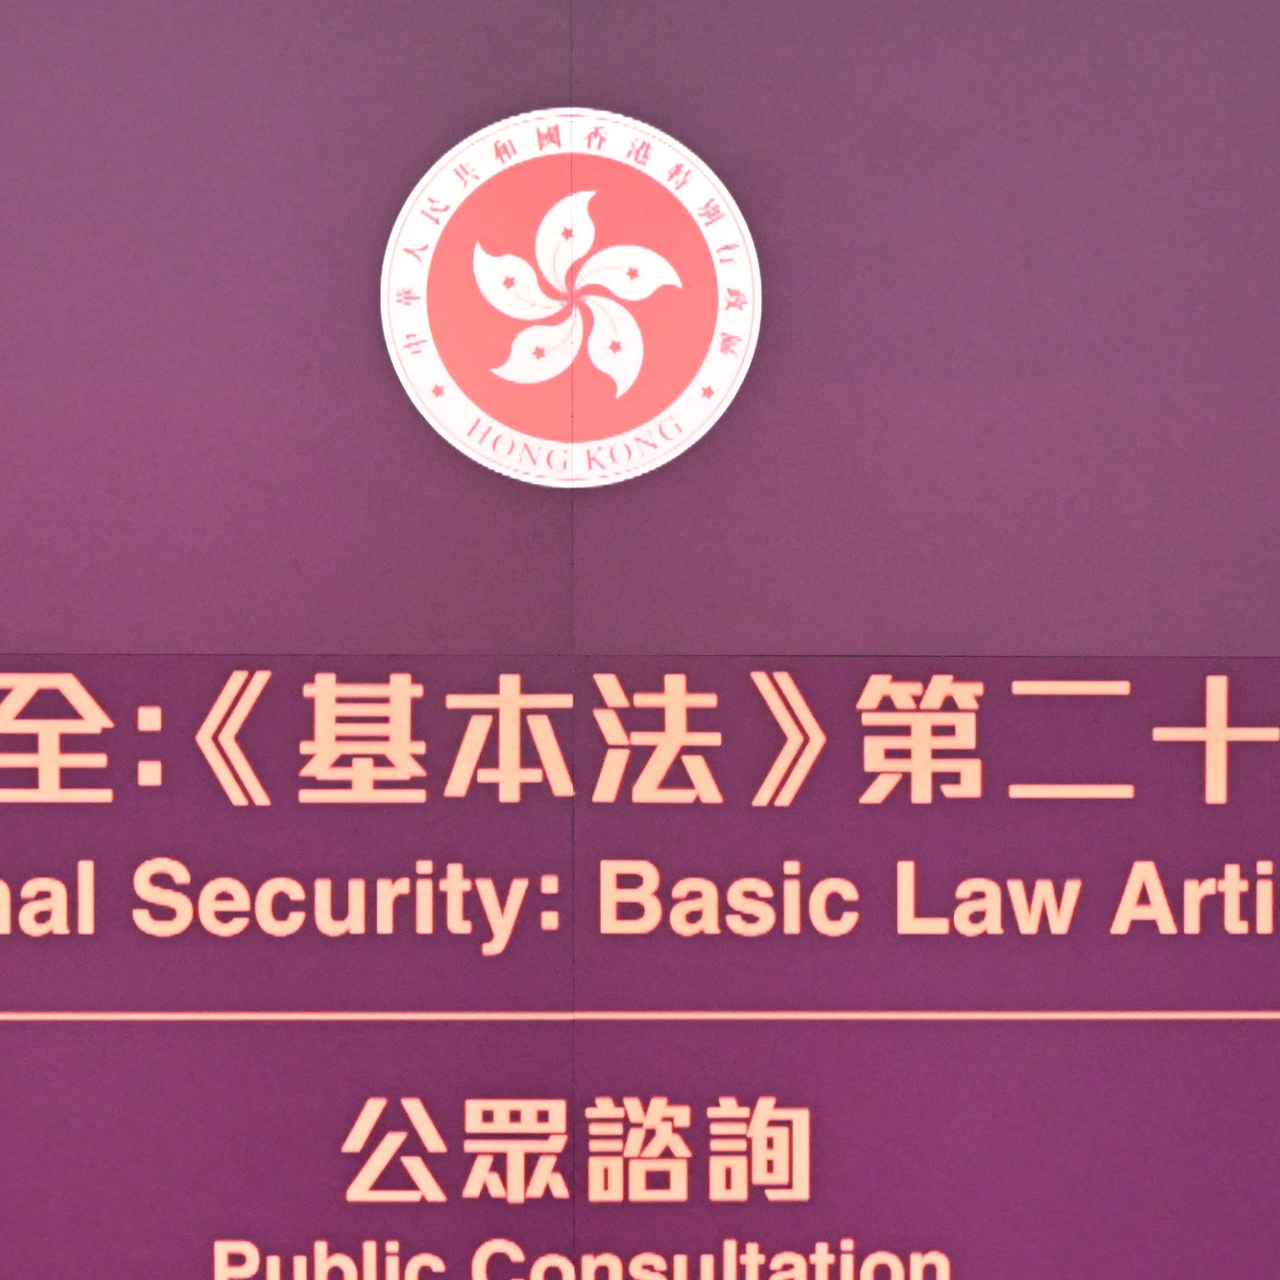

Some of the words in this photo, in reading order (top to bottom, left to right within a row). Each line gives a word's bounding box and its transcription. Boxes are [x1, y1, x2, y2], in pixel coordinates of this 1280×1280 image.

[466, 417, 568, 472] HONG
[585, 415, 683, 471] KONG
[131, 857, 560, 956] Security:
[599, 858, 860, 938] Basic
[895, 860, 1083, 937] Law
[340, 1096, 811, 1203] 公眾諮詢
